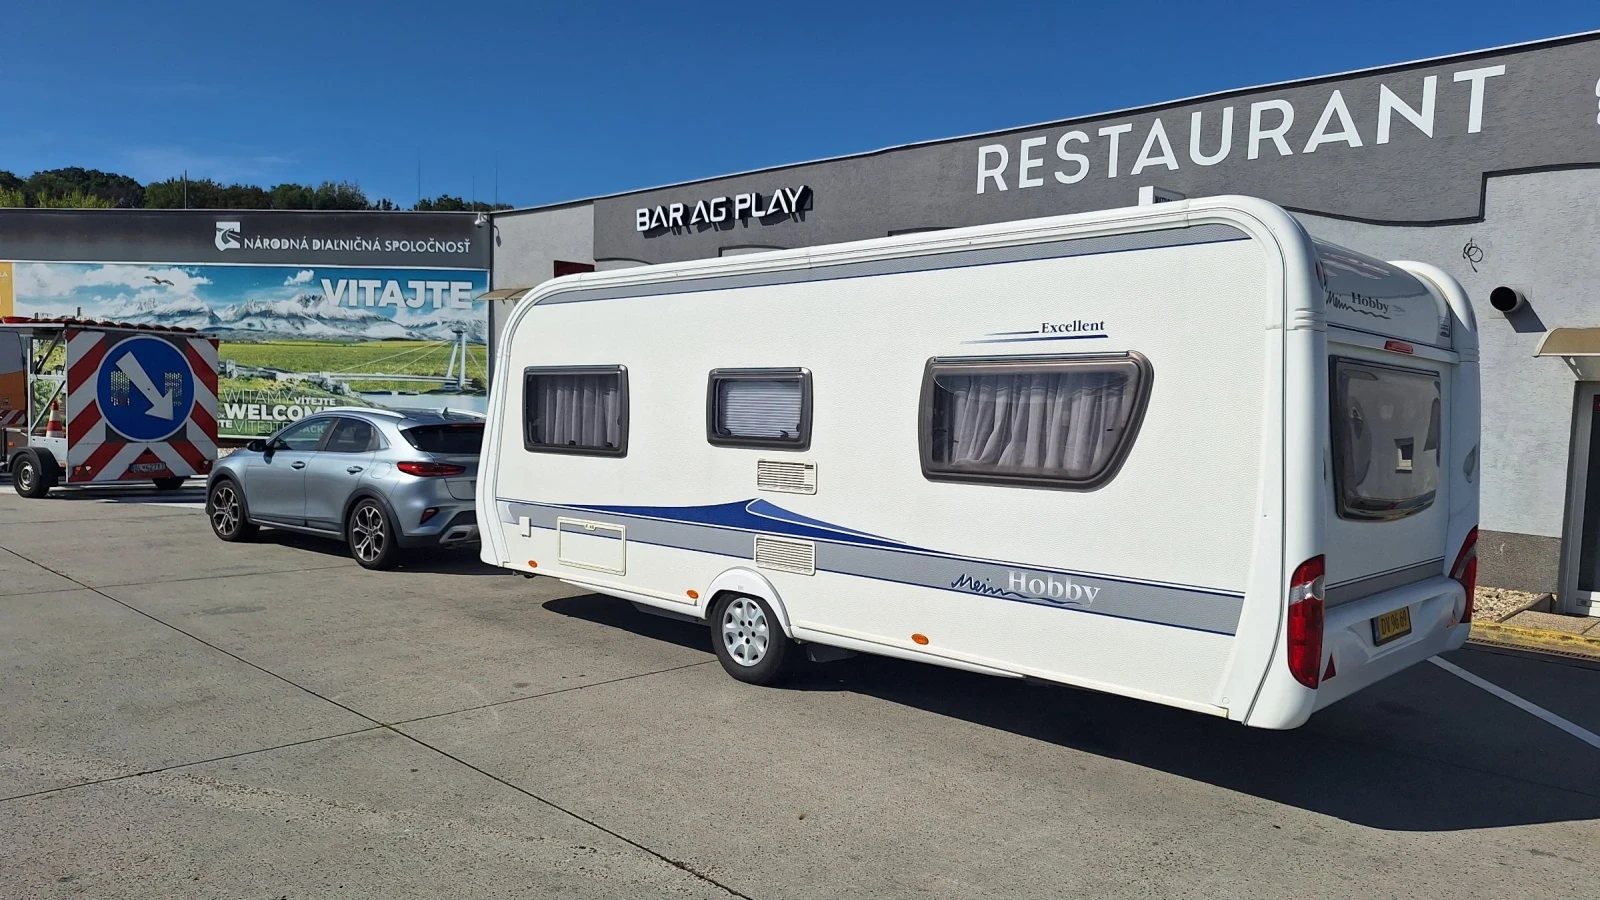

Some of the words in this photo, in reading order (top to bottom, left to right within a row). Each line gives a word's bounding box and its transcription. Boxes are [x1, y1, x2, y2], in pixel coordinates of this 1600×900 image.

[976, 64, 1507, 195] RESTAURANT
[636, 202, 684, 232] BAR
[690, 196, 727, 225] AG
[735, 185, 805, 220] PLAY
[244, 235, 309, 250] NÁRODNÁ
[312, 237, 382, 251] DIAĽNIČNÁ
[385, 237, 471, 253] SPOLOČNOSŤ
[320, 278, 473, 309] VITAJTE
[1351, 291, 1390, 314] Hobby
[1041, 320, 1105, 334] Excellent
[223, 388, 293, 405] WITAMY
[223, 403, 333, 421] WELCOM
[951, 573, 1006, 596] Mein
[1007, 570, 1101, 607] Hobby
